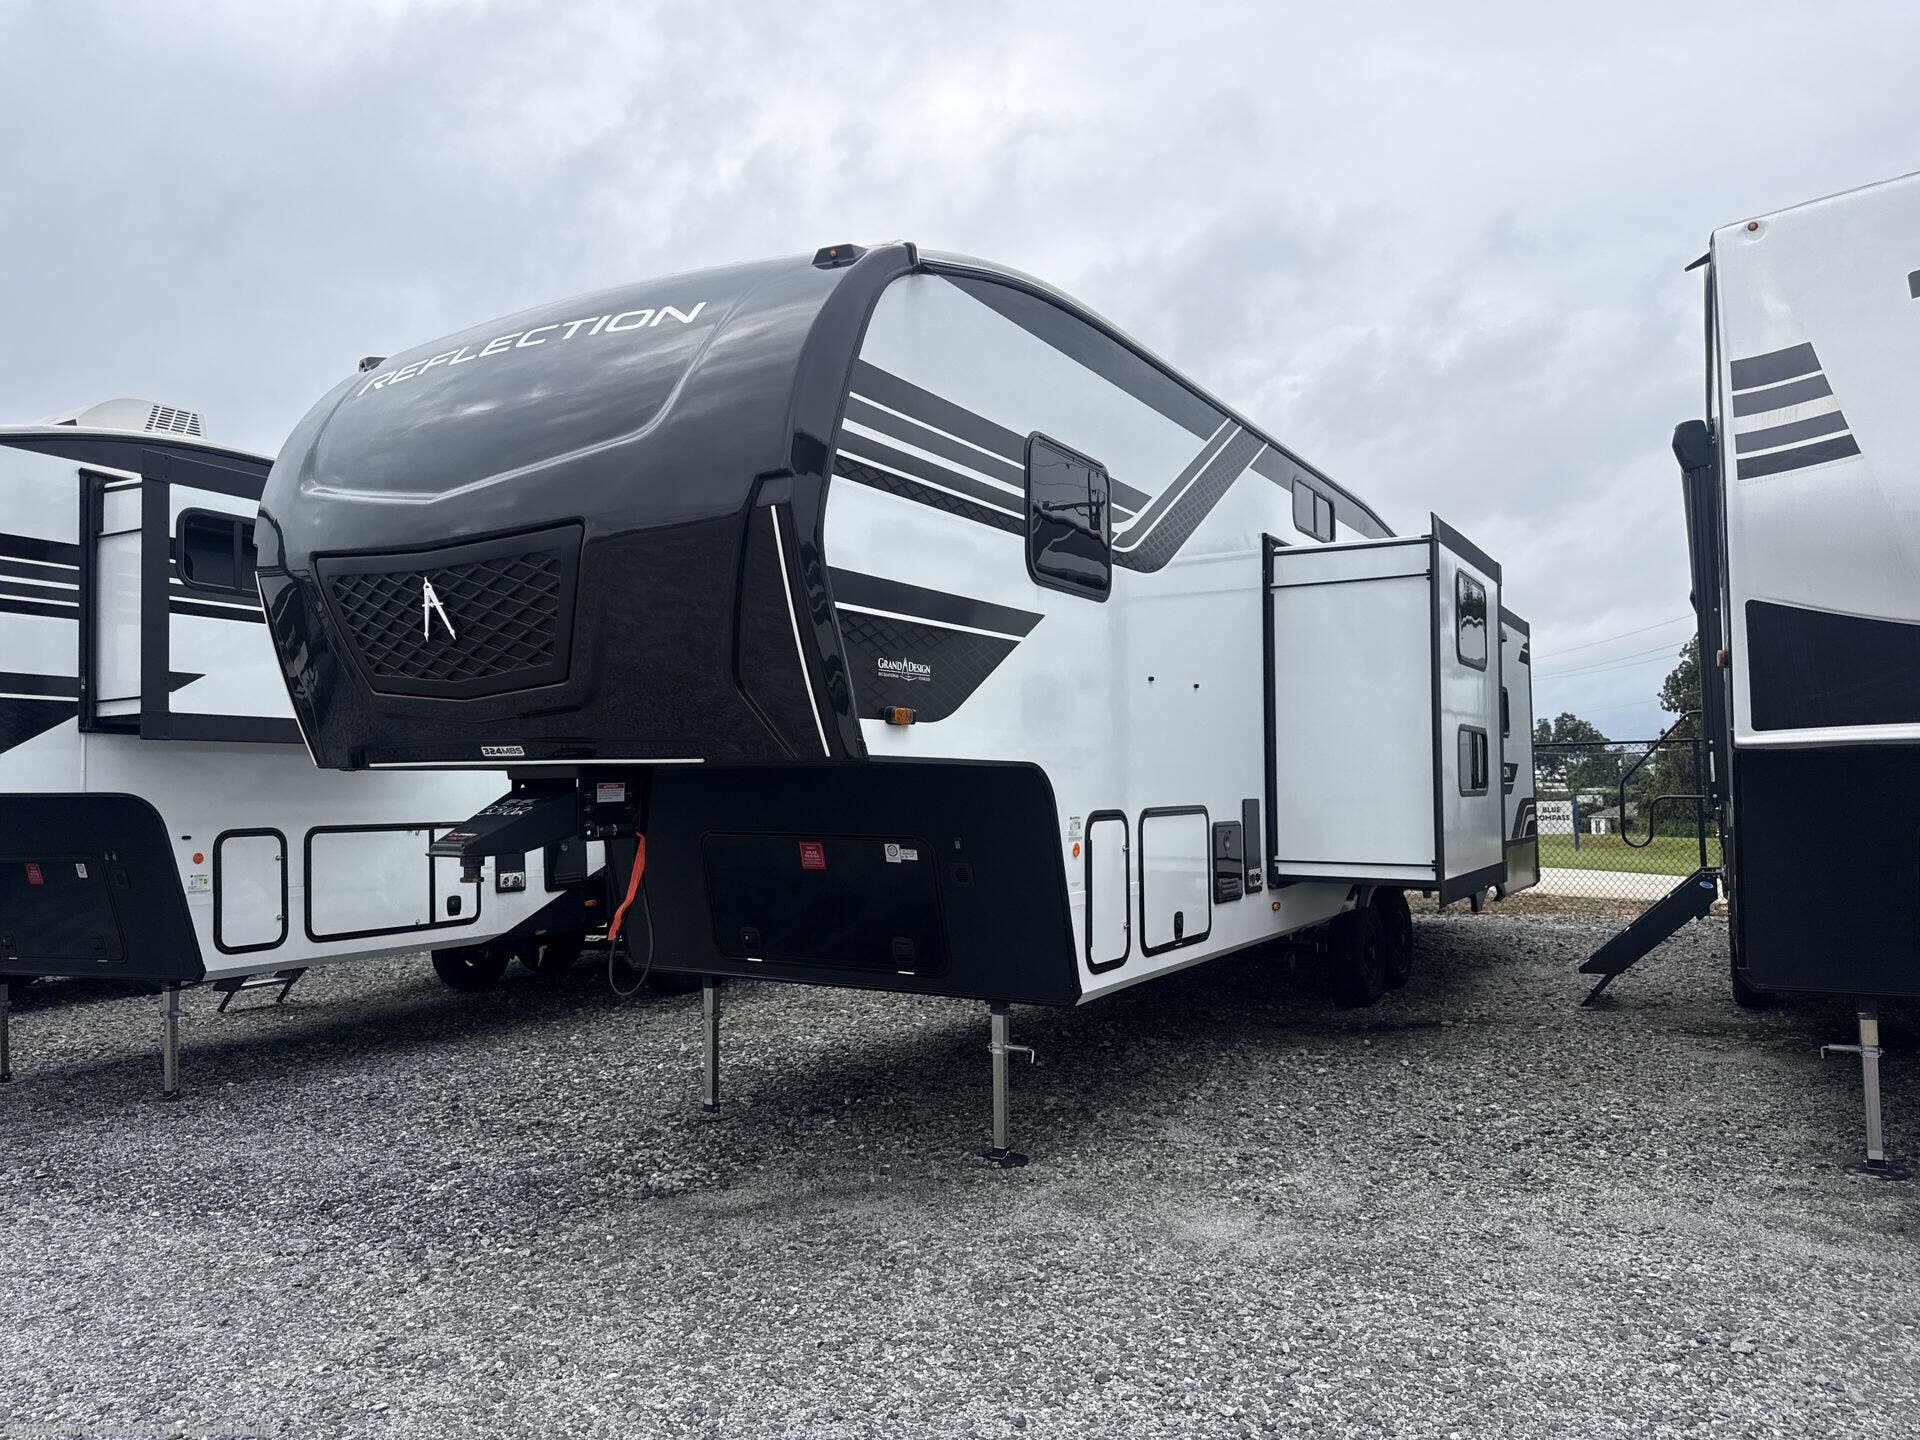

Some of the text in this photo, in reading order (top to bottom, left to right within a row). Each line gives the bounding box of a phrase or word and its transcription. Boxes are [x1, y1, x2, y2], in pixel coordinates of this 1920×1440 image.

[356, 301, 707, 397] REFLECTION
[877, 657, 931, 674] GRAND DESIGN
[1542, 806, 1561, 814] BLUE
